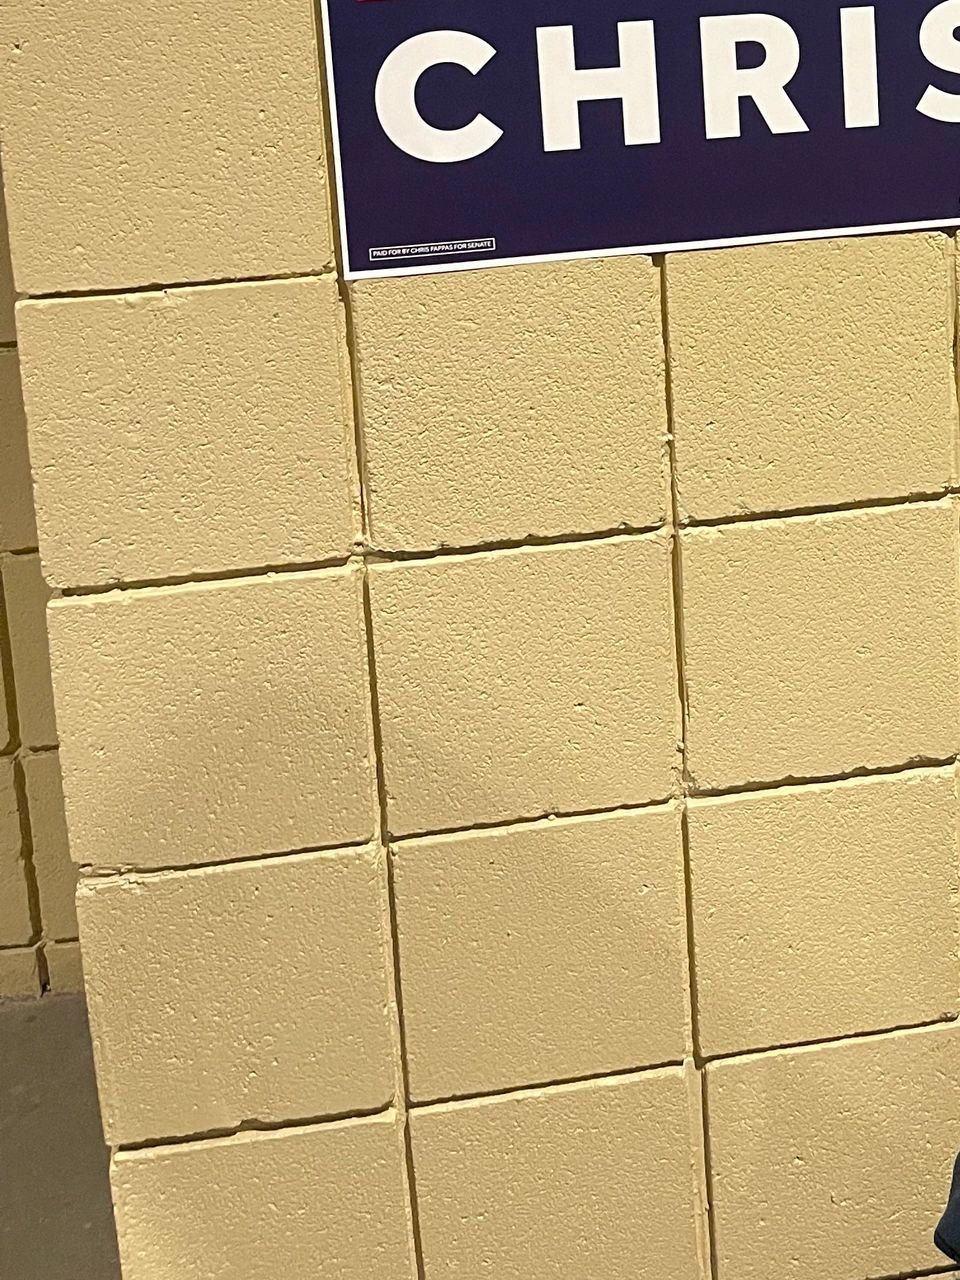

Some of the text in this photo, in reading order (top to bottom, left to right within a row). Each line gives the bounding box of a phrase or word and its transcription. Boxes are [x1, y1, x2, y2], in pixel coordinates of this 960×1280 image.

[373, 249, 387, 257] PAID
[388, 248, 400, 256] FOR
[401, 247, 410, 255] BY
[410, 246, 429, 254] CHRIS
[430, 244, 453, 253] PAPPAS
[467, 240, 491, 249] SENATE
